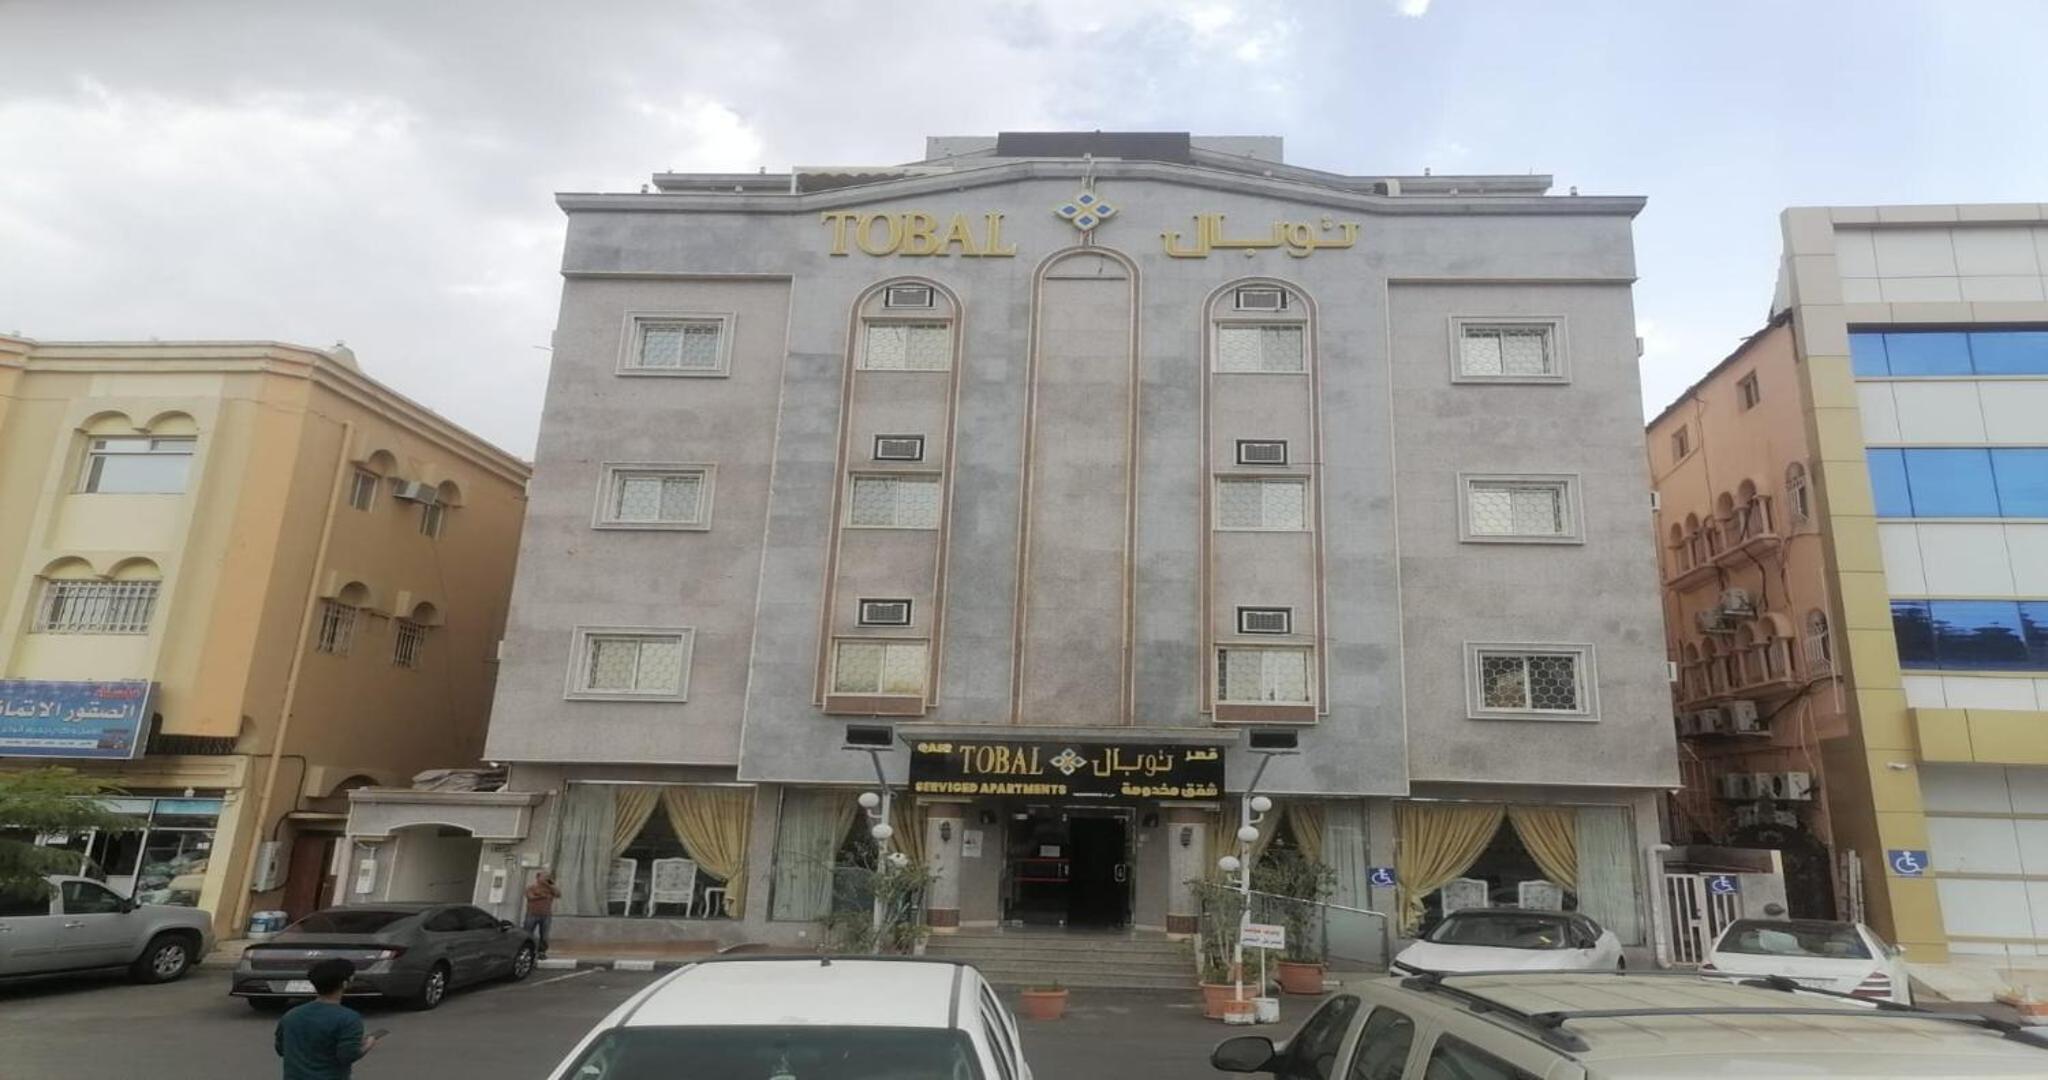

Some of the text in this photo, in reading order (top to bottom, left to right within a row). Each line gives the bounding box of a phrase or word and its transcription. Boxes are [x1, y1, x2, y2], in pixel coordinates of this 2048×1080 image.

[820, 211, 1016, 258] TOBAL
[1160, 212, 1361, 258] توبال
[960, 745, 1044, 775] TOBAL
[1092, 747, 1219, 777] قصر توبال
[915, 781, 979, 793] SERVICED
[980, 782, 1068, 796] APARTMENTS
[1121, 782, 1179, 797] مخدومة
[1181, 782, 1218, 797] شقق
